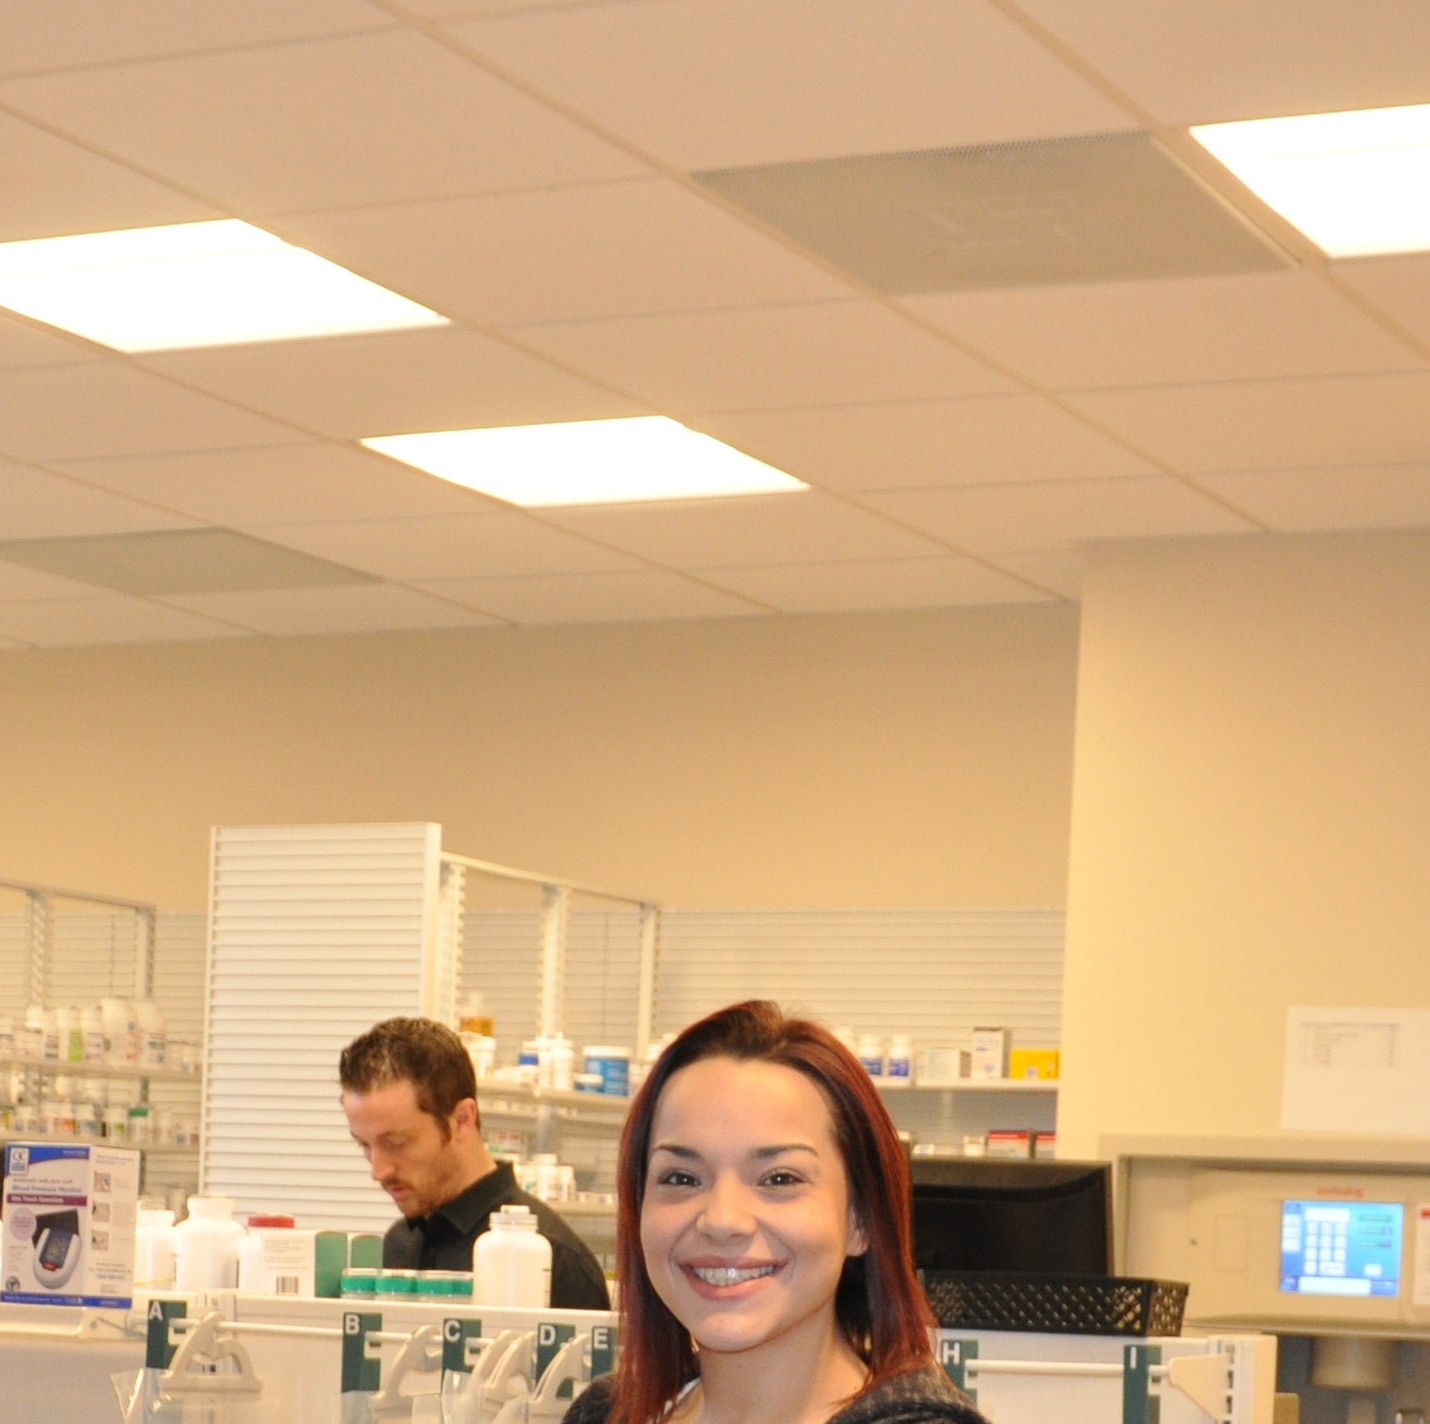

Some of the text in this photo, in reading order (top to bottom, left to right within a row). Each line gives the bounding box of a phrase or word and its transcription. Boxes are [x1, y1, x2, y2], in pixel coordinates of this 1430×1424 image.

[148, 1301, 164, 1321] A
[345, 1314, 360, 1335] B
[443, 1321, 461, 1342] C
[539, 1325, 556, 1346] D
[593, 1329, 608, 1350] E
[942, 1341, 961, 1365] H
[1129, 1346, 1138, 1370] I
